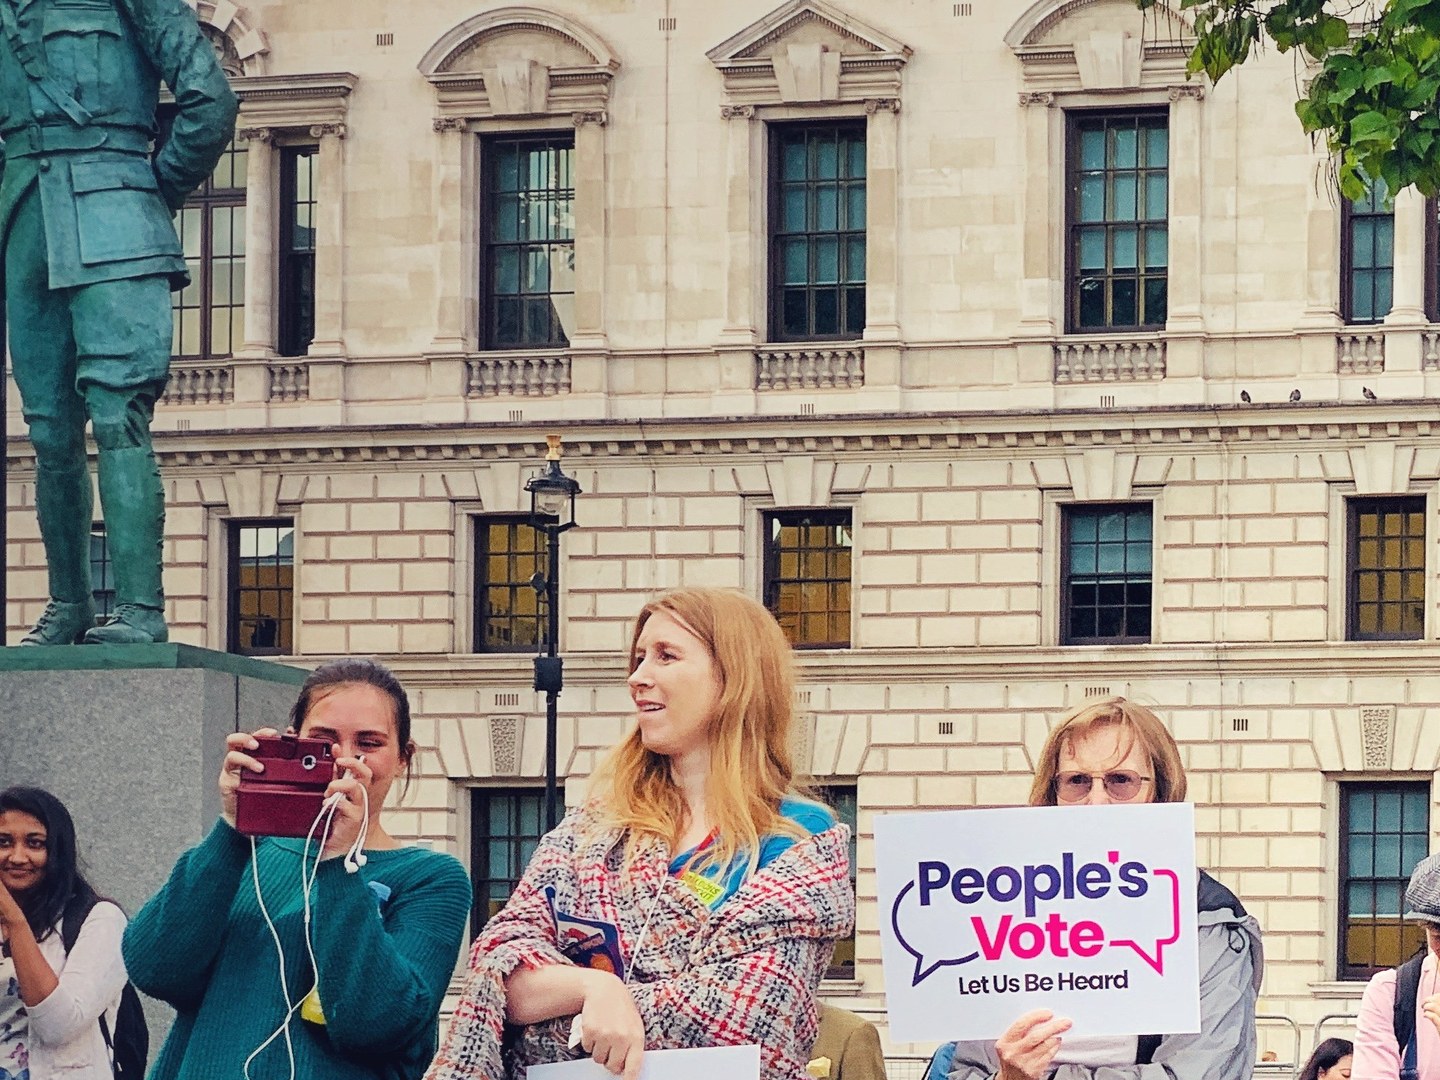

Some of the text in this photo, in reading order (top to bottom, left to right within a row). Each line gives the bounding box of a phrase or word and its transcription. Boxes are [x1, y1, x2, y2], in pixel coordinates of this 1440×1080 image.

[918, 851, 1148, 918] People's
[970, 913, 1105, 961] Vote
[959, 969, 1129, 995] Let Us Be Heard
